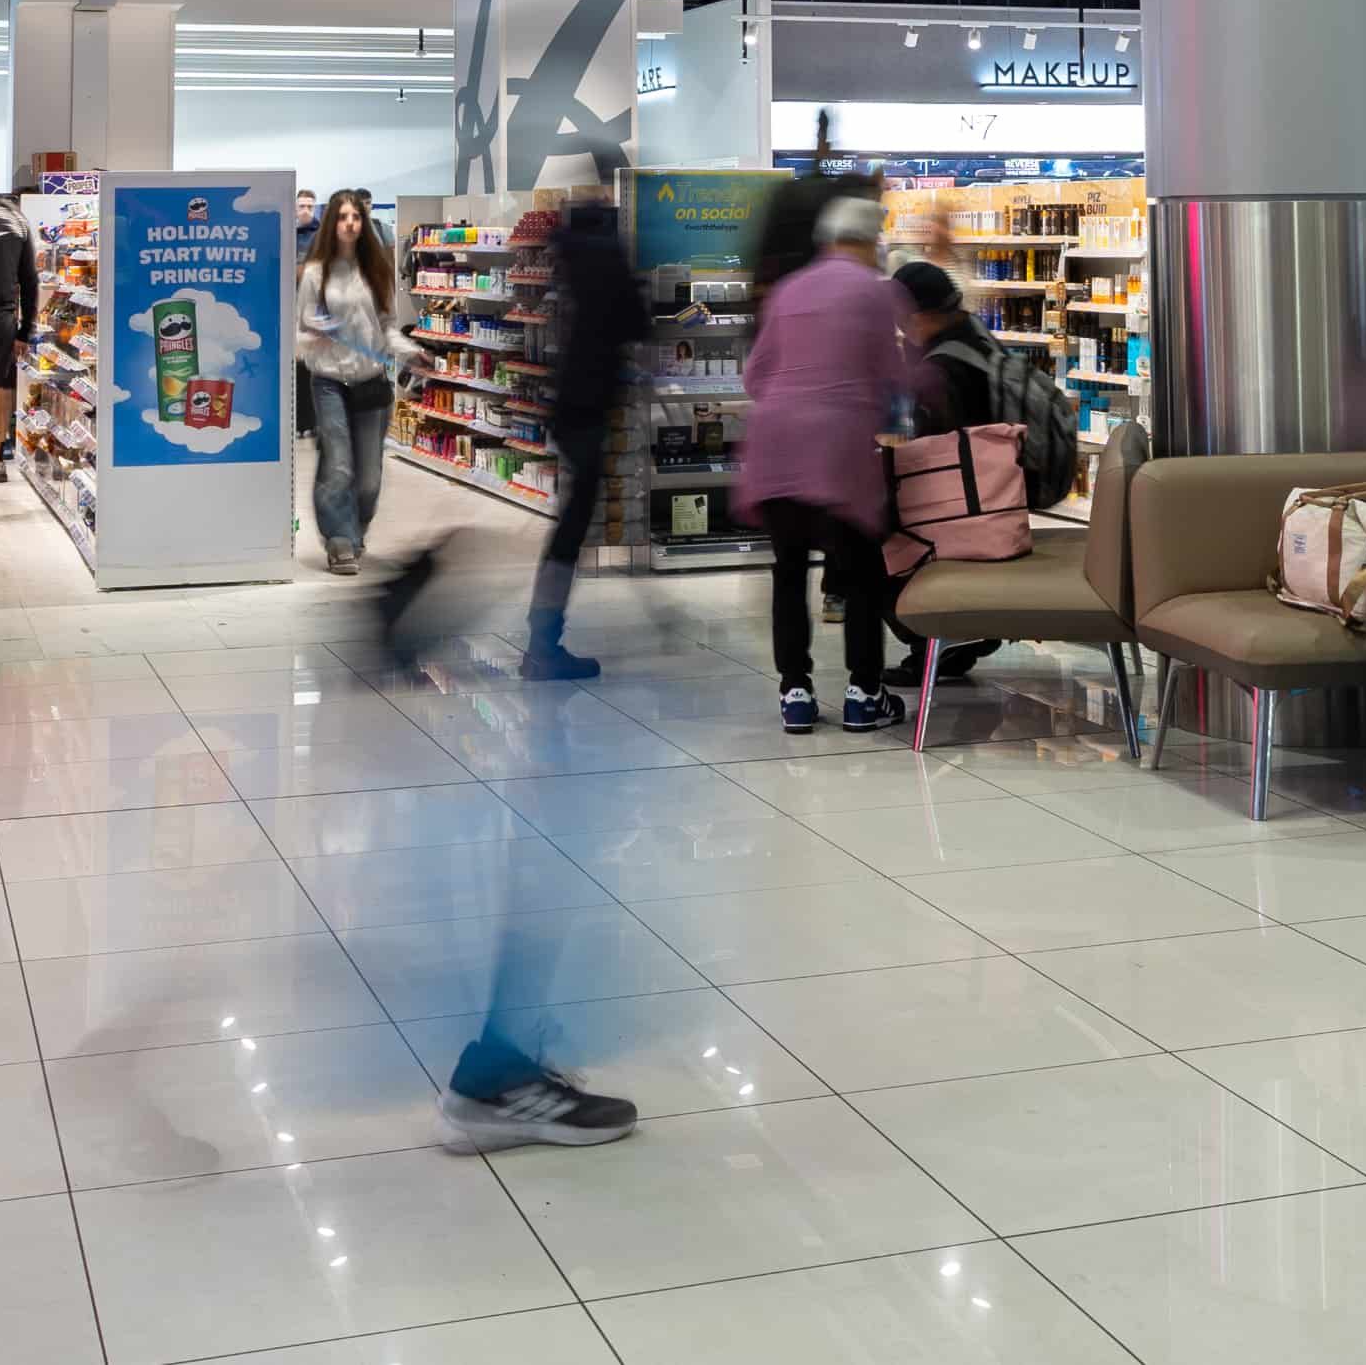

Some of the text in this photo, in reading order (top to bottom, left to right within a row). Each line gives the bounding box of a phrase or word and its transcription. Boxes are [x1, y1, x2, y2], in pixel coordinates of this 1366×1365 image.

[637, 66, 663, 94] ARE
[994, 61, 1130, 85] MAKE UP
[960, 114, 998, 140] N7
[675, 202, 752, 220] on social
[147, 226, 249, 242] HOLIDAYS
[139, 247, 256, 265] START WITH
[150, 268, 245, 285] PRINGLES
